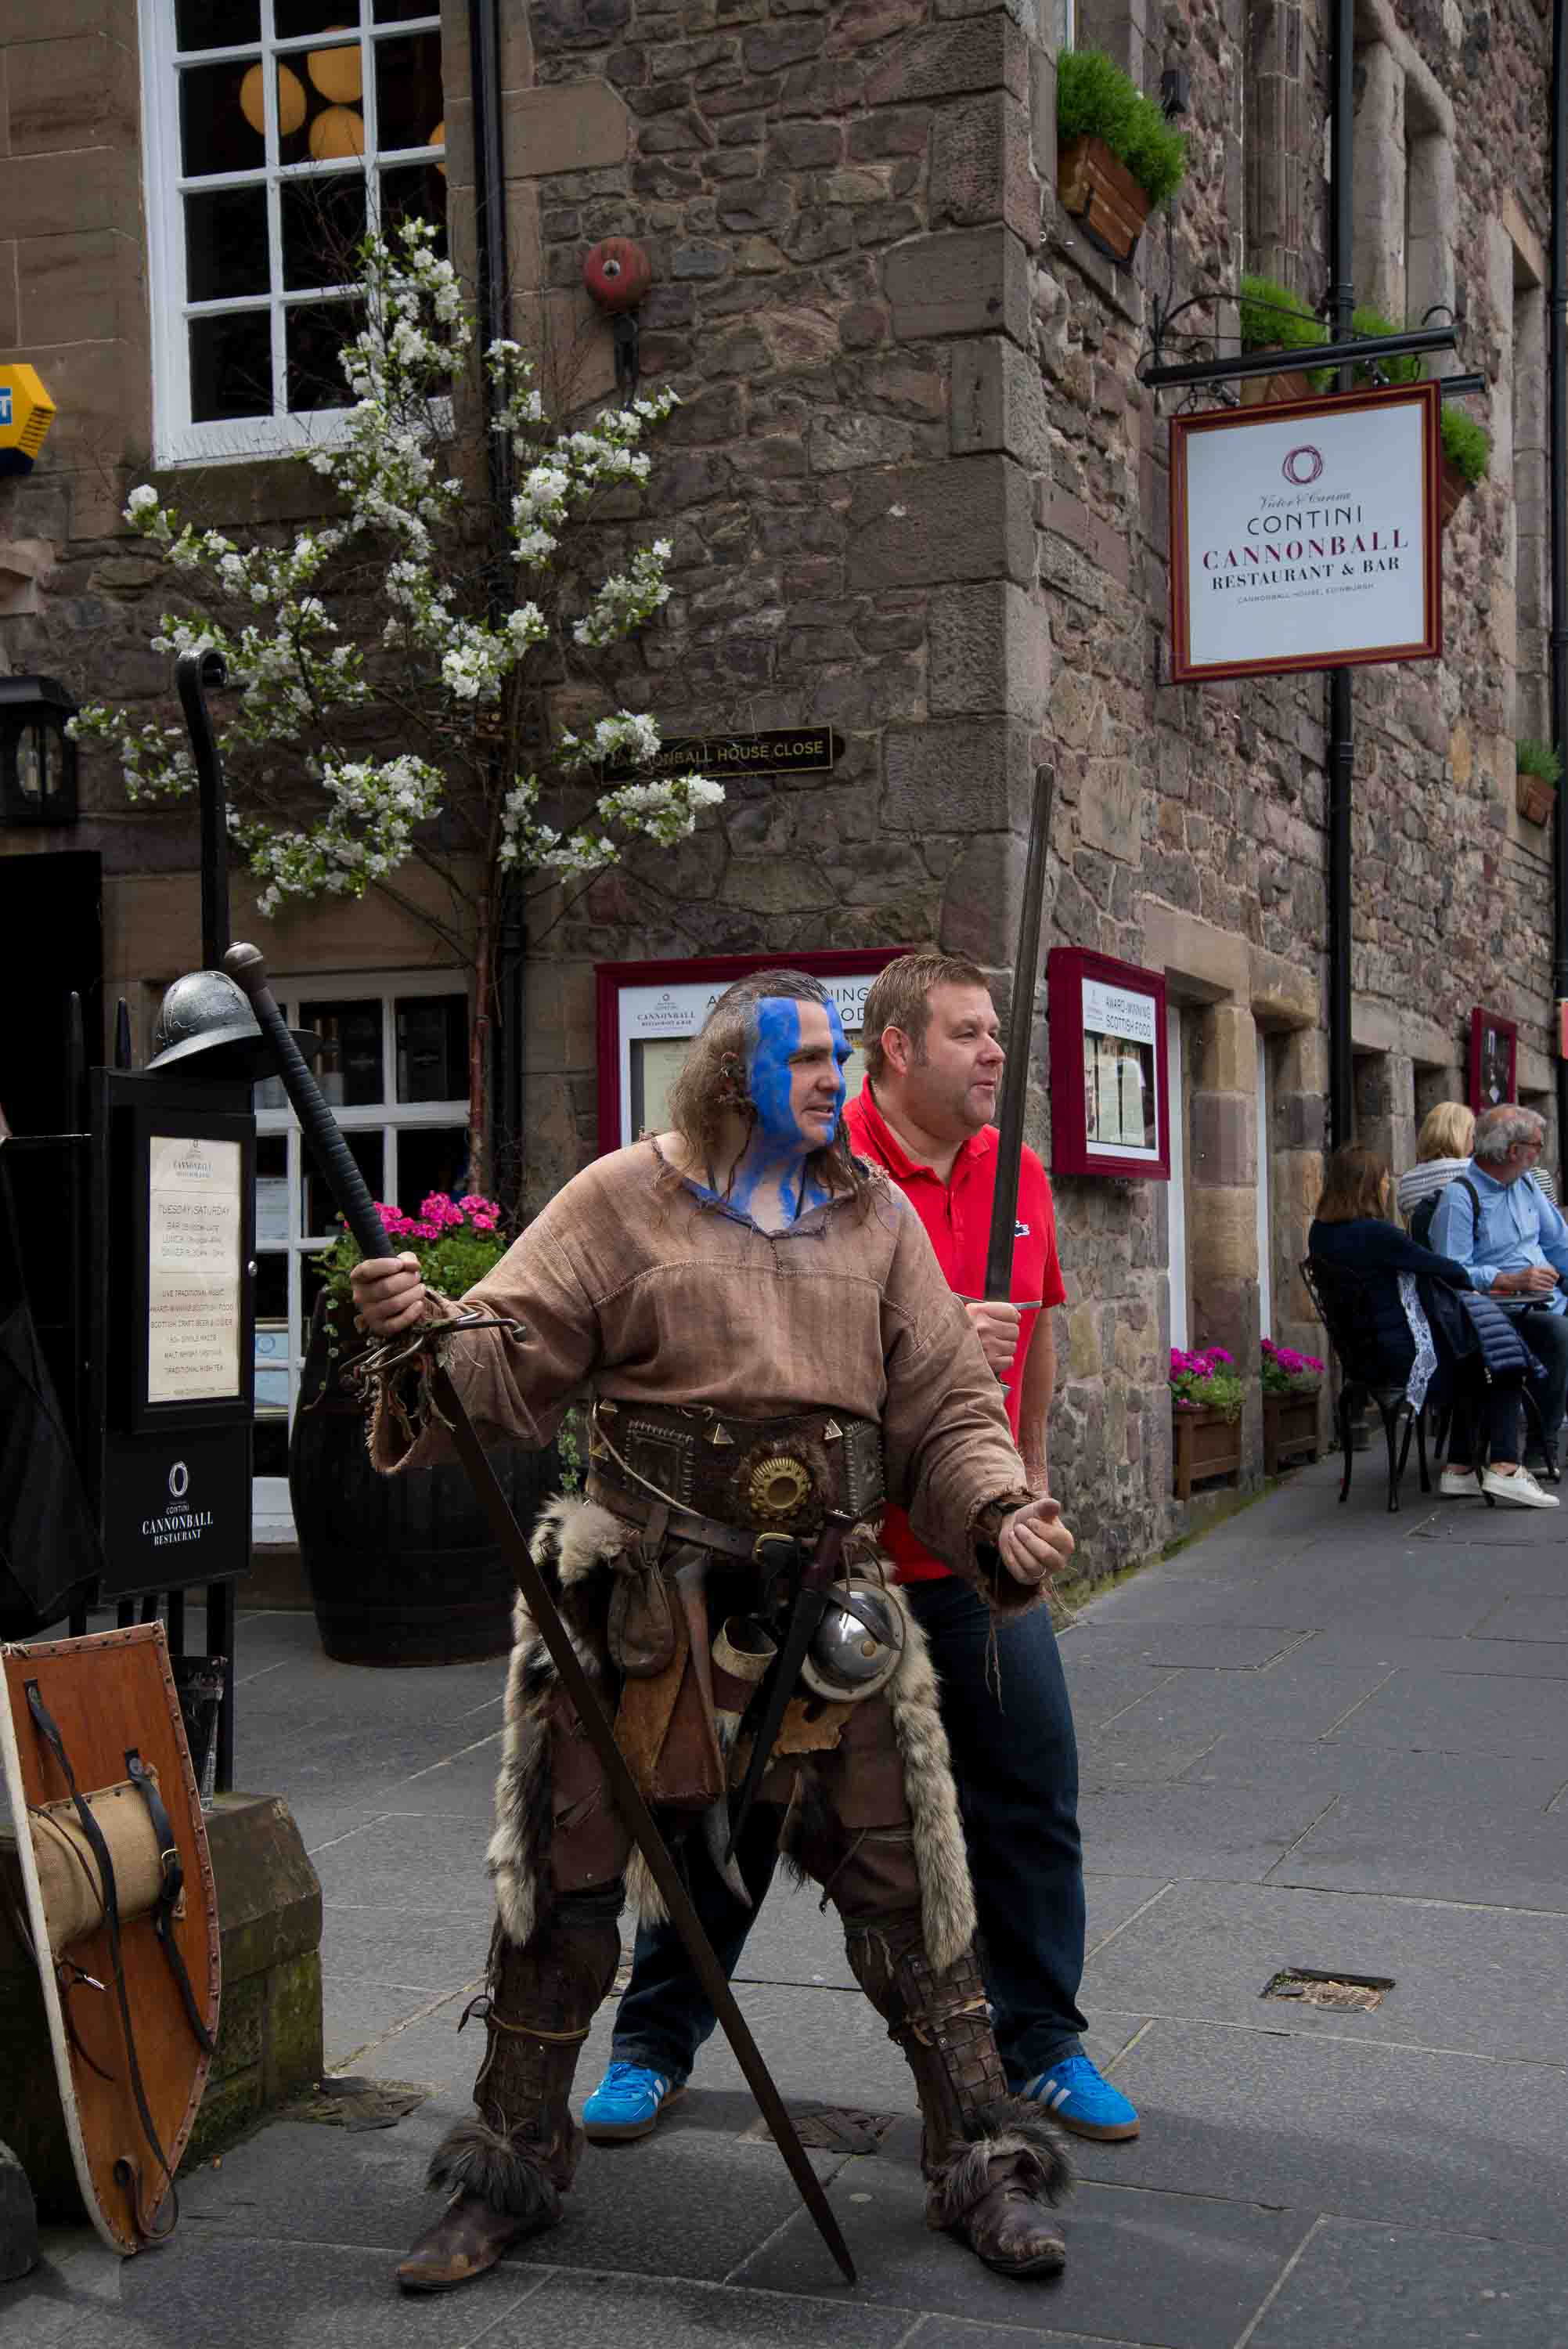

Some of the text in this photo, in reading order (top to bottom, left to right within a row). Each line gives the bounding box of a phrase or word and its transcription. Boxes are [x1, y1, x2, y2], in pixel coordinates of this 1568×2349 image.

[1247, 505, 1362, 536] CONTINI
[1202, 529, 1409, 571] CANNONBALL
[1212, 556, 1400, 591] RESTAURANT & BAR
[716, 745, 769, 763] HOUSE
[773, 740, 823, 758] CLOSE
[1106, 1014, 1151, 1037] SCOTTISH FOOD
[142, 1510, 213, 1535] CANNONBALL
[154, 1529, 200, 1546] RESTAURANT
